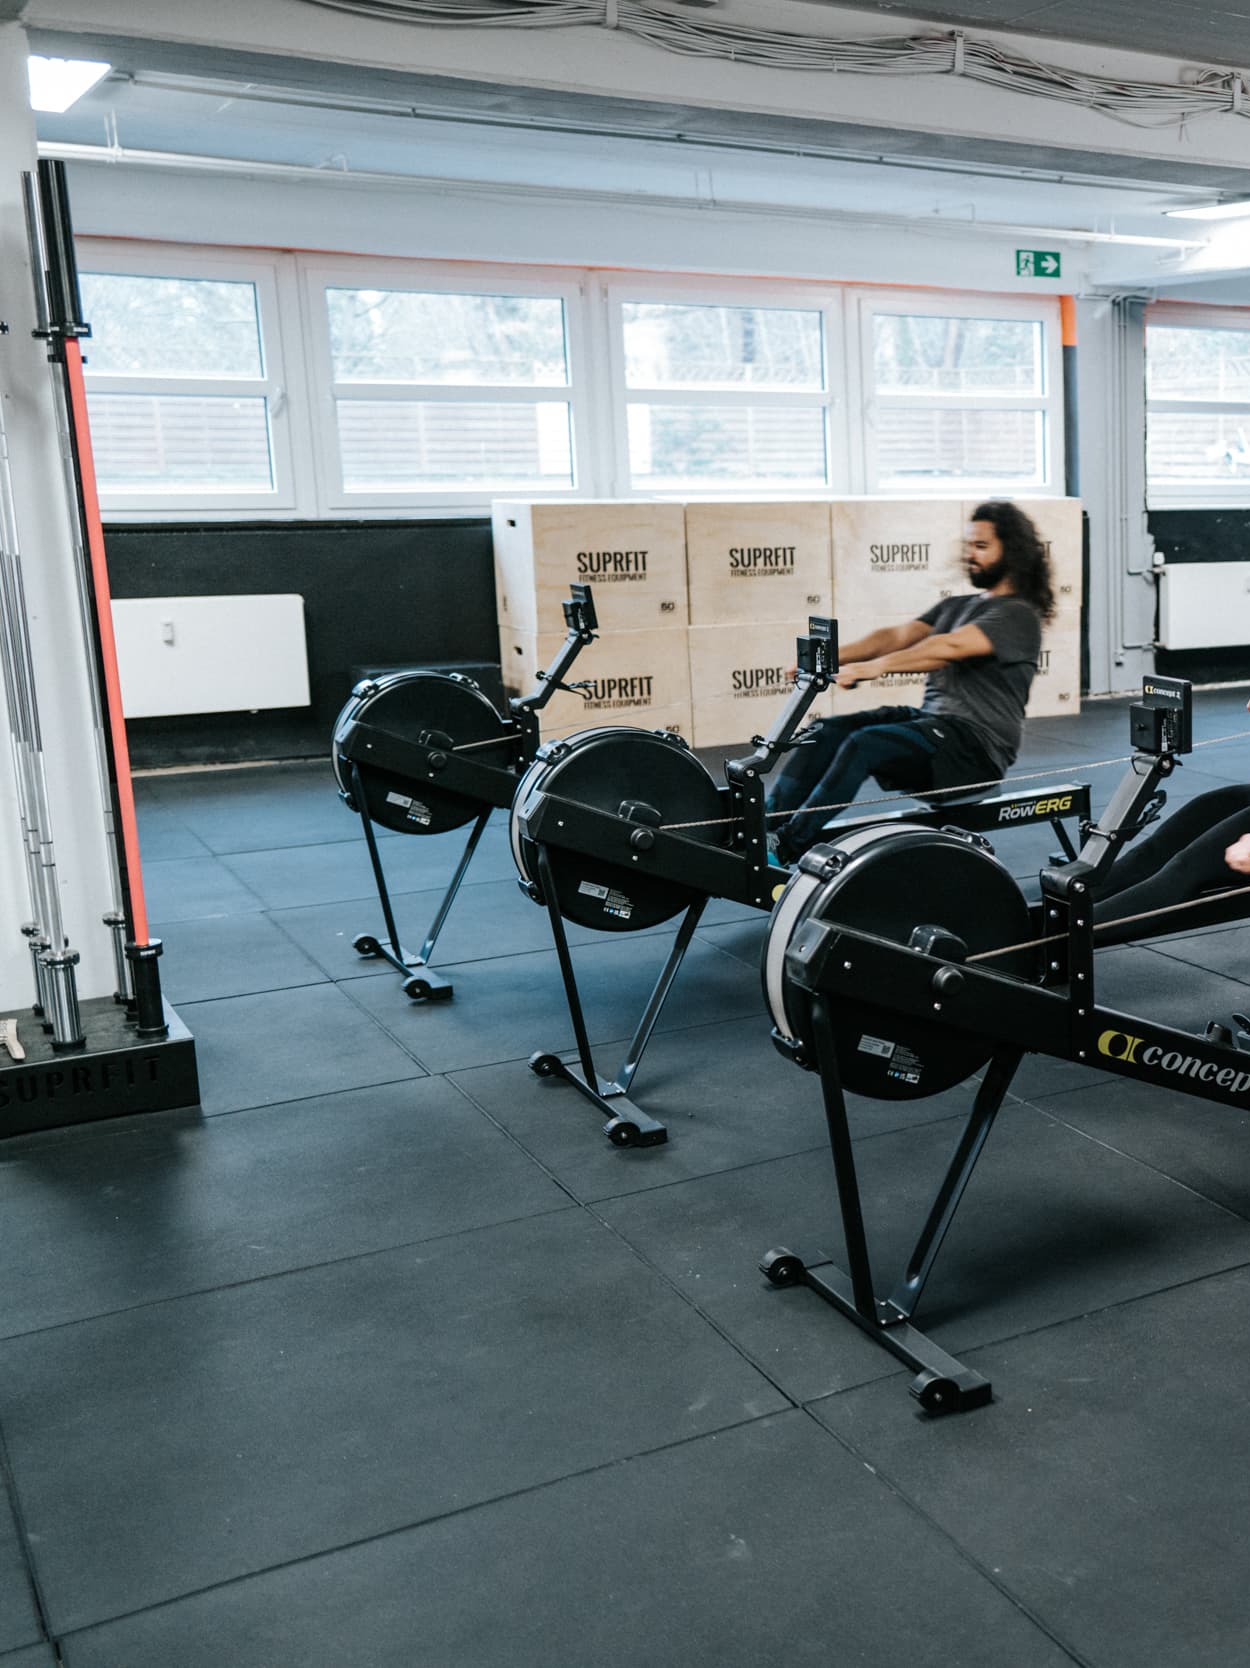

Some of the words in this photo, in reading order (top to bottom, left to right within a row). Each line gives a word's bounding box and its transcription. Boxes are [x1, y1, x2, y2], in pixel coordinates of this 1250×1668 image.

[577, 550, 649, 574] SUPRFIT
[729, 547, 796, 568] SUPRFIT
[870, 543, 931, 564] SUPRFIT
[579, 574, 607, 583] FITNESS
[608, 572, 648, 583] EQUIPMENT
[730, 569, 757, 577] FITNESS
[758, 567, 794, 577] EQUIPMENT
[582, 676, 654, 701] SUPRFIT
[584, 701, 612, 710] FITNESS
[613, 698, 652, 709] EQUIPMENT
